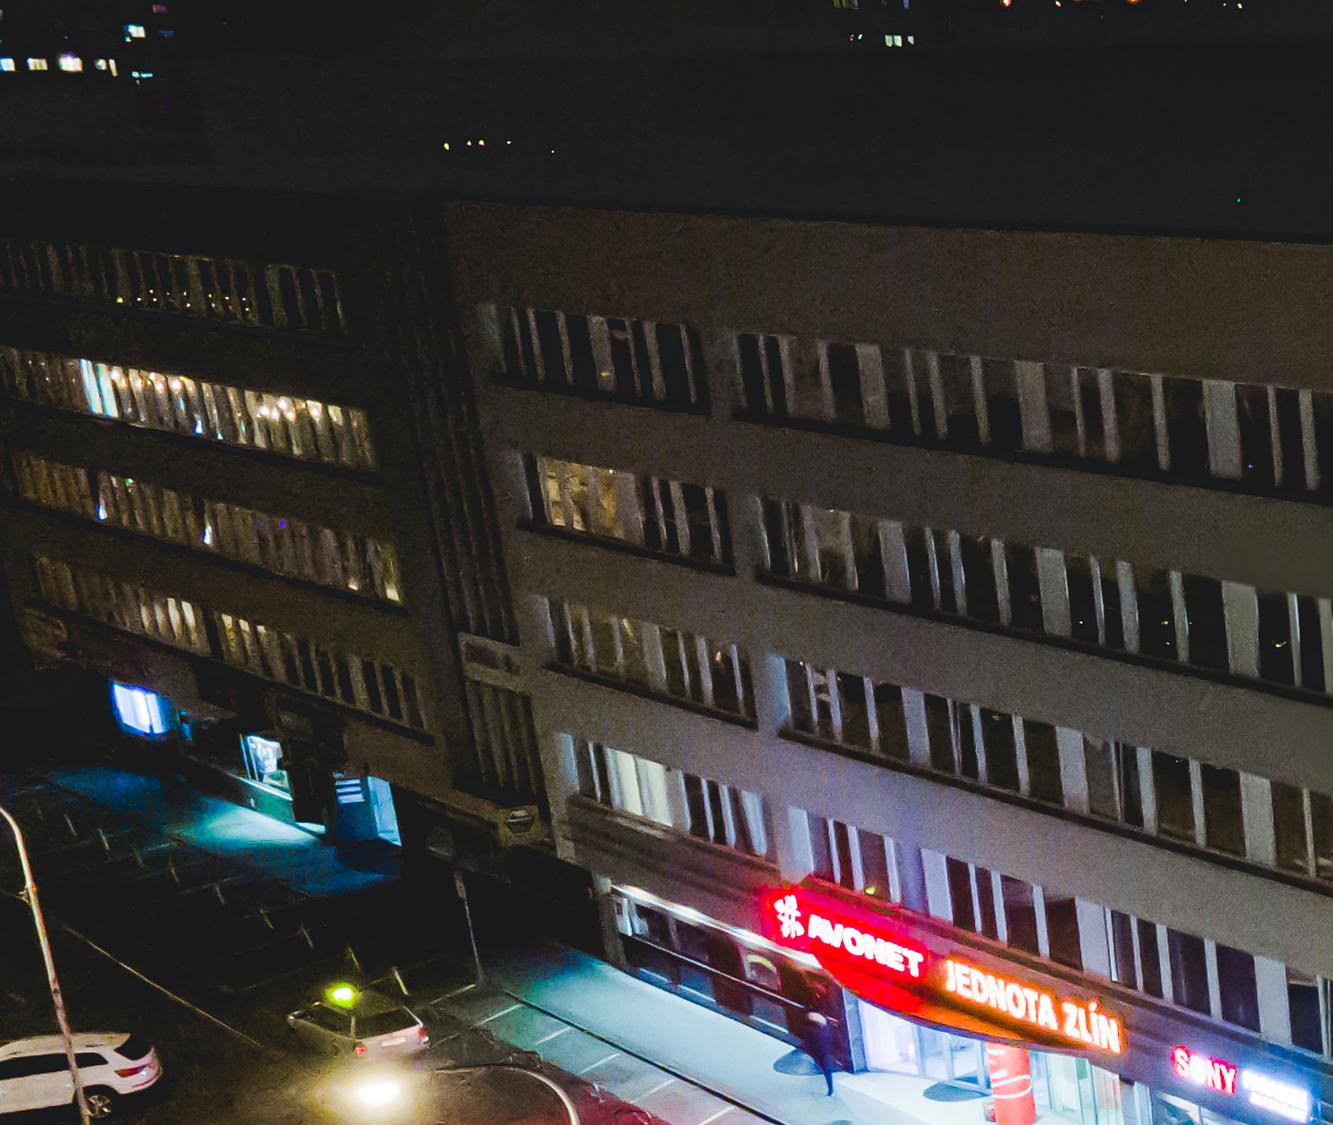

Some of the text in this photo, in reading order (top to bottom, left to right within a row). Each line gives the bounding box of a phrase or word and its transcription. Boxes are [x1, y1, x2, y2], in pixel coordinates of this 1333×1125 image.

[808, 915, 924, 977] AVONET
[945, 960, 1121, 1054] JEDNOTA ZLÍN
